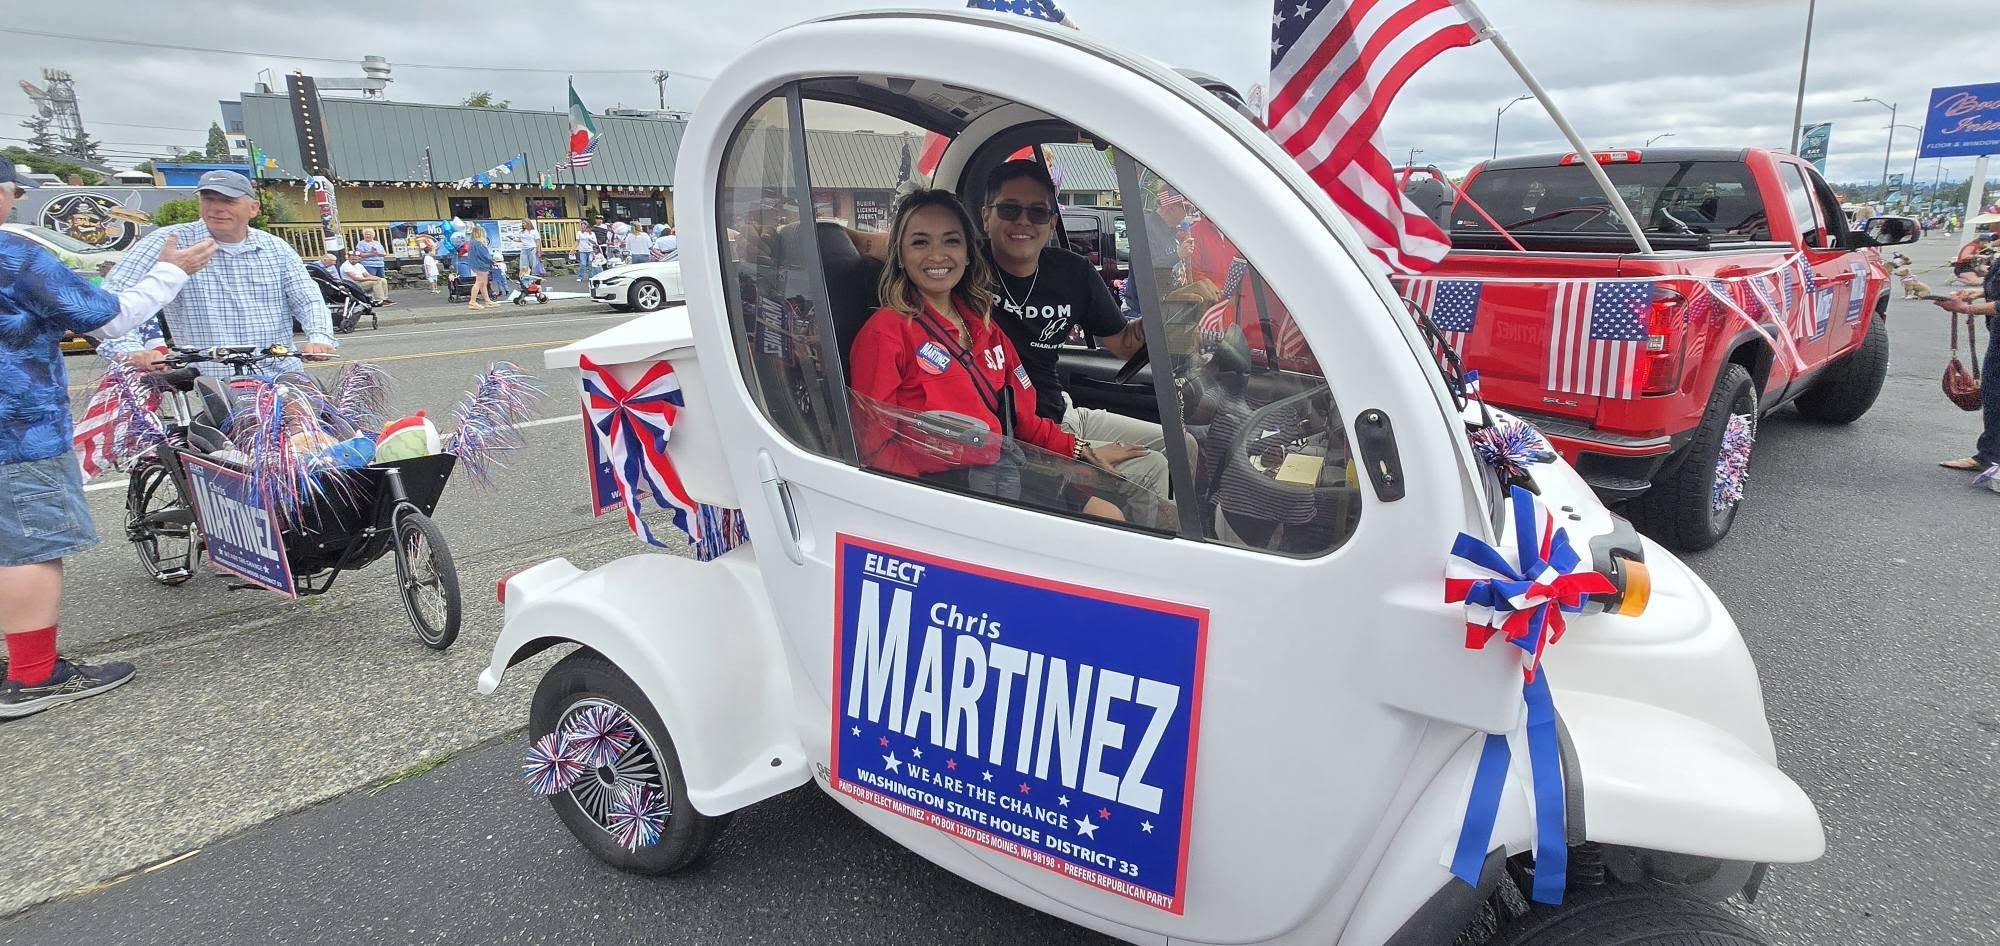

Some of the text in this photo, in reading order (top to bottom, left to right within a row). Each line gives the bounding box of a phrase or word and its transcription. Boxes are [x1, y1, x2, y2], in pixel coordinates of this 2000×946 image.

[991, 293, 1071, 320] REDOM
[919, 341, 950, 370] MARTINEZ
[191, 474, 280, 562] MARTINEZ
[863, 552, 925, 587] ELECT
[930, 602, 1001, 639] Chris
[847, 579, 1181, 815] MARTINEZ
[857, 767, 945, 810] WASHINGTON
[946, 801, 988, 825] STATE
[989, 815, 1040, 843] HOUSE
[1045, 834, 1117, 869] DISTRICT
[1118, 859, 1139, 877] 33
[907, 763, 1069, 830] WE ARE THE CHANGE
[838, 780, 1173, 909] PAID FOR BY ELECT MARTINEZ PO BOX 13207 DES MOINES, WA 98198 PREFERS REPUBLICAN PARTY
